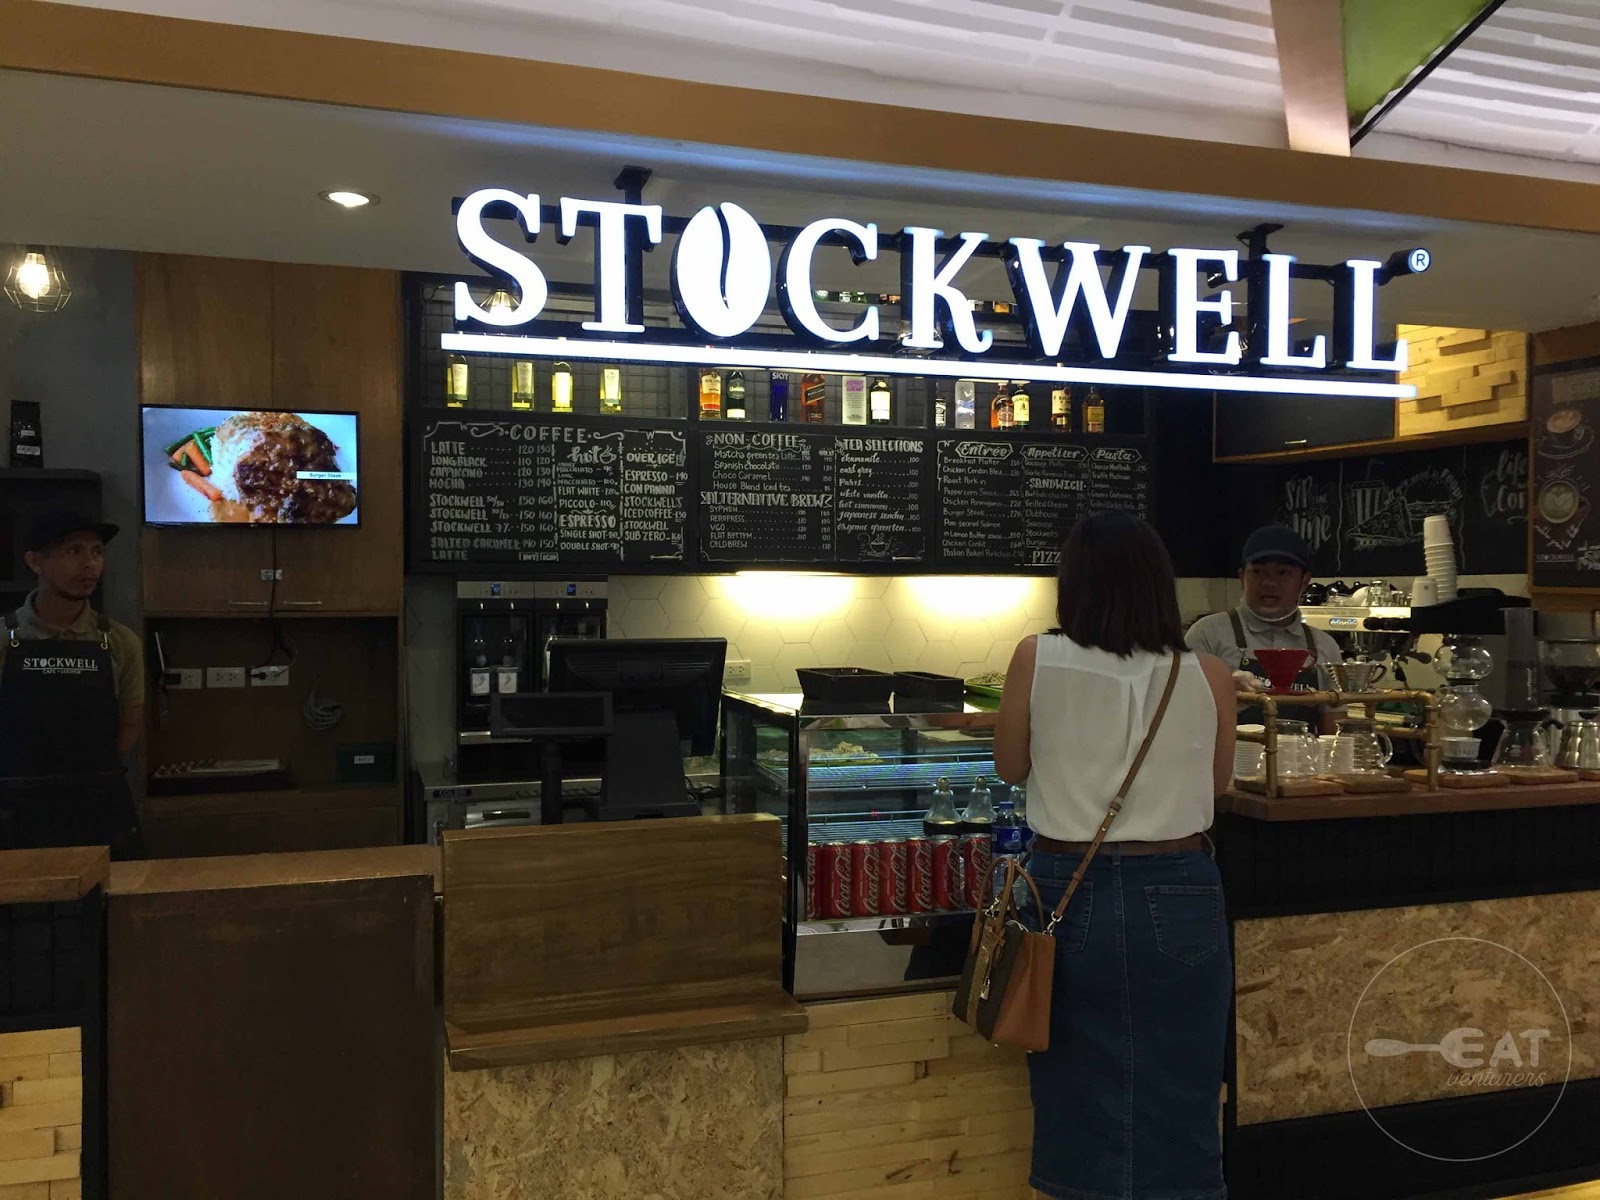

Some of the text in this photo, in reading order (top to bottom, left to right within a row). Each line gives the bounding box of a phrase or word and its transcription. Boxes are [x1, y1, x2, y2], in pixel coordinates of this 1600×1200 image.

[454, 188, 1409, 371] STOCKWELL
[509, 424, 587, 444] COFFEE
[714, 433, 800, 448] NON-COFFEE
[843, 438, 924, 453] TEA SELECTIONS
[431, 441, 534, 455] LATTE 120
[625, 452, 656, 464] OVER
[714, 450, 746, 460] Matcha
[431, 455, 551, 468] LONG BLACK 110 120
[714, 460, 780, 471] Spanish chocolate
[518, 468, 532, 478] 120
[556, 466, 594, 474] MACCHIATO
[942, 465, 967, 474] Chicken
[967, 466, 989, 474] Cordon
[624, 469, 668, 482] ESPRESSO
[712, 471, 737, 480] Choco
[738, 471, 771, 481] Caramel
[943, 475, 962, 484] Roast
[963, 476, 979, 484] Pork
[429, 478, 551, 490] MOCHA 130 140
[557, 478, 596, 486] MACCHIATO
[713, 480, 737, 490] House
[740, 481, 760, 491] Blend
[1029, 477, 1084, 491] SANDWICH
[558, 486, 576, 496] FLAT
[576, 486, 601, 497] WHITE
[624, 482, 676, 495] CON PANNA
[429, 492, 486, 508] STOCKWELL
[518, 496, 535, 506] 150
[538, 496, 554, 505] 160
[559, 499, 612, 509] PICCOLO 110
[705, 491, 789, 507] ALTERNATIVE
[942, 496, 969, 506] Chicken
[429, 507, 553, 521] STOCKWELL 150 160
[623, 508, 645, 519] ICED
[644, 508, 673, 519] COFFEE
[942, 507, 985, 517] Burger Steak
[559, 514, 617, 529] ESPRESSO
[624, 520, 670, 531] STOCKWELL
[430, 521, 554, 534] STOCKWELL 150 160
[560, 530, 587, 539] SINGLE
[588, 530, 607, 540] SHOT
[624, 531, 666, 542] SUB ZERO
[710, 531, 726, 540] FLAT
[430, 536, 470, 549] SALTED
[473, 537, 521, 550] CARAMEL
[539, 539, 555, 548] 150
[560, 541, 590, 550] DOUBLE
[591, 541, 608, 550] SHOT
[727, 541, 748, 549] BREW
[432, 549, 468, 561] LATTE
[23, 657, 98, 669] STOCKWELL
